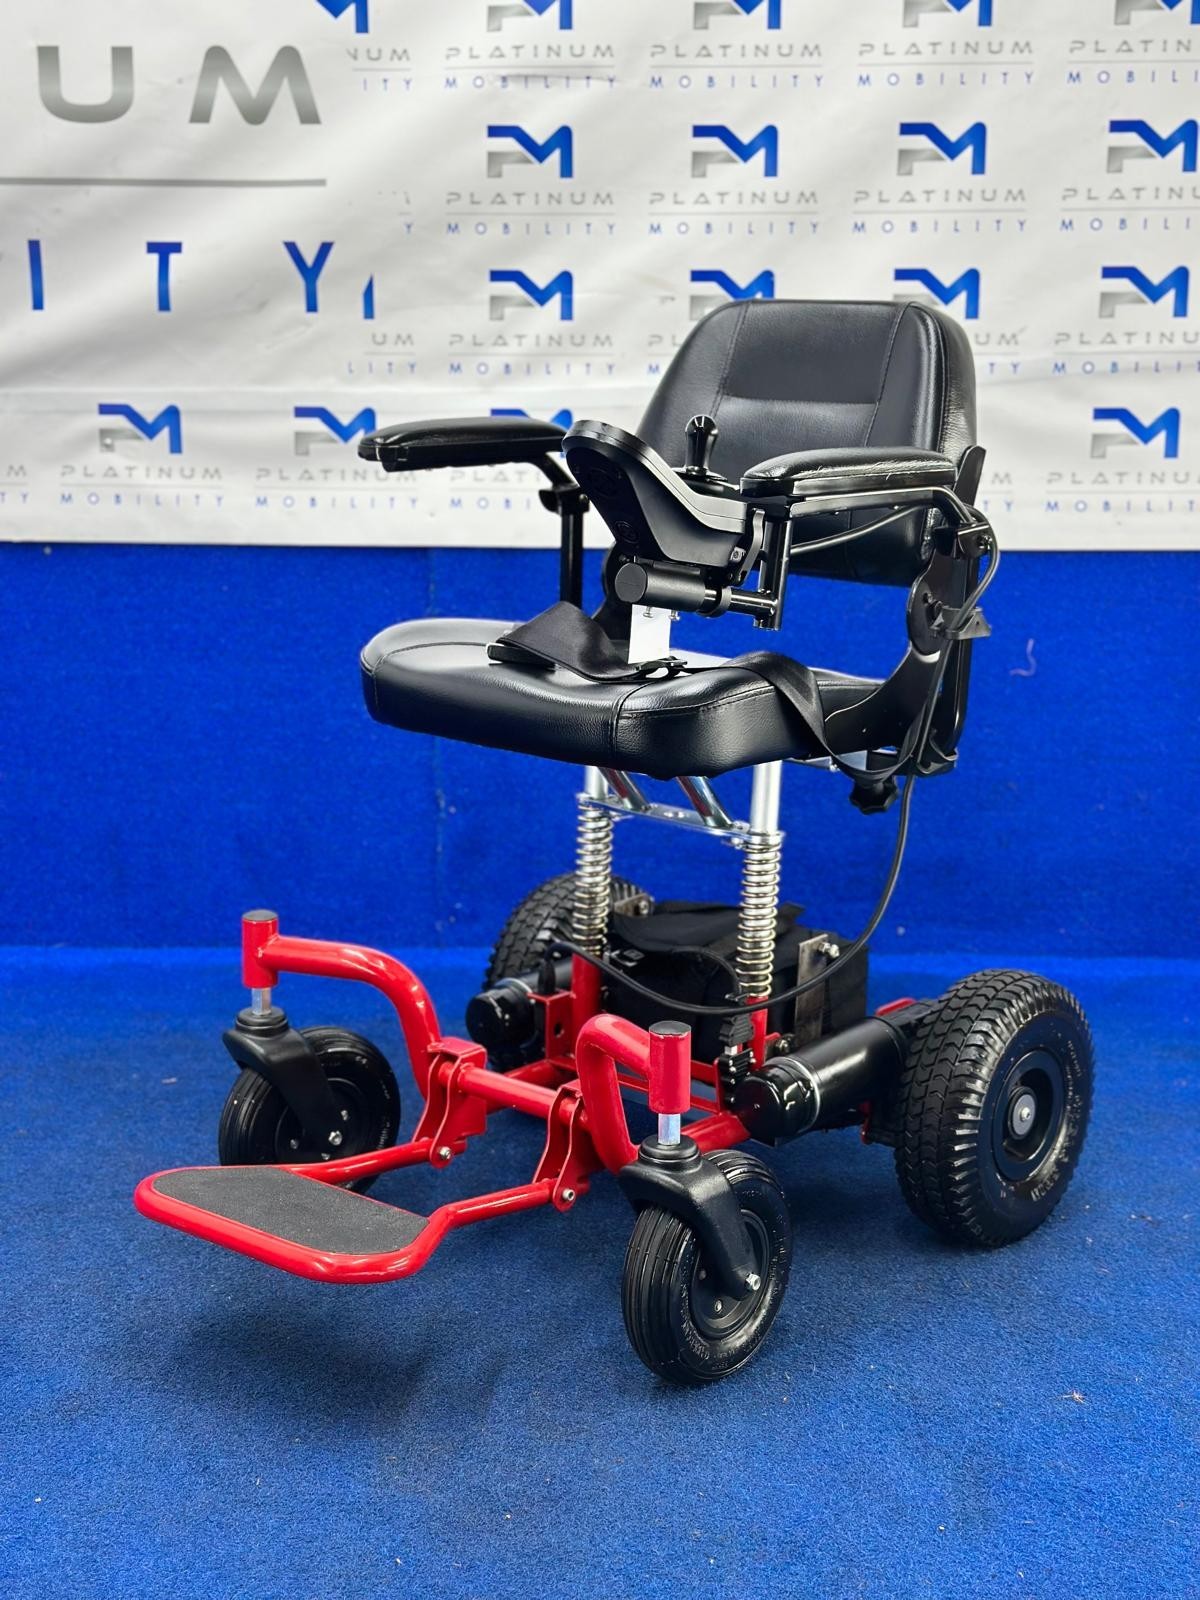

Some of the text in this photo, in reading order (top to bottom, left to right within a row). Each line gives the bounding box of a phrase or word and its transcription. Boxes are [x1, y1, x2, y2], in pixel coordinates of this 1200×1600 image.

[446, 44, 614, 60] PLATINUM
[650, 44, 822, 59] PLATINUM
[858, 40, 1033, 57] PLATINUM
[1069, 39, 1191, 53] PLATIN
[445, 74, 616, 89] MOBILITY
[650, 75, 823, 89] MOBILITY
[858, 71, 1033, 86] MOBILITY
[1067, 69, 1199, 83] MOBILI
[446, 191, 614, 206] PLATINUM
[649, 191, 818, 206] PLATINUM
[853, 188, 1026, 203] PLATINUM
[447, 222, 615, 235] MOBILITY
[649, 222, 819, 235] MOBILITY
[852, 219, 1026, 233] MOBILITY
[1060, 217, 1190, 231] MOBILI
[449, 333, 613, 347] PLATINUM
[450, 361, 615, 375] MOBILITY
[60, 465, 222, 479] PLATINUM
[256, 468, 417, 482] PLATINUM
[1047, 471, 1200, 485] PLATINU
[61, 492, 223, 507] MOBILITY
[256, 496, 418, 509] MOBILITY
[450, 497, 530, 510] MOBI
[1044, 500, 1195, 512] MOBILIT
